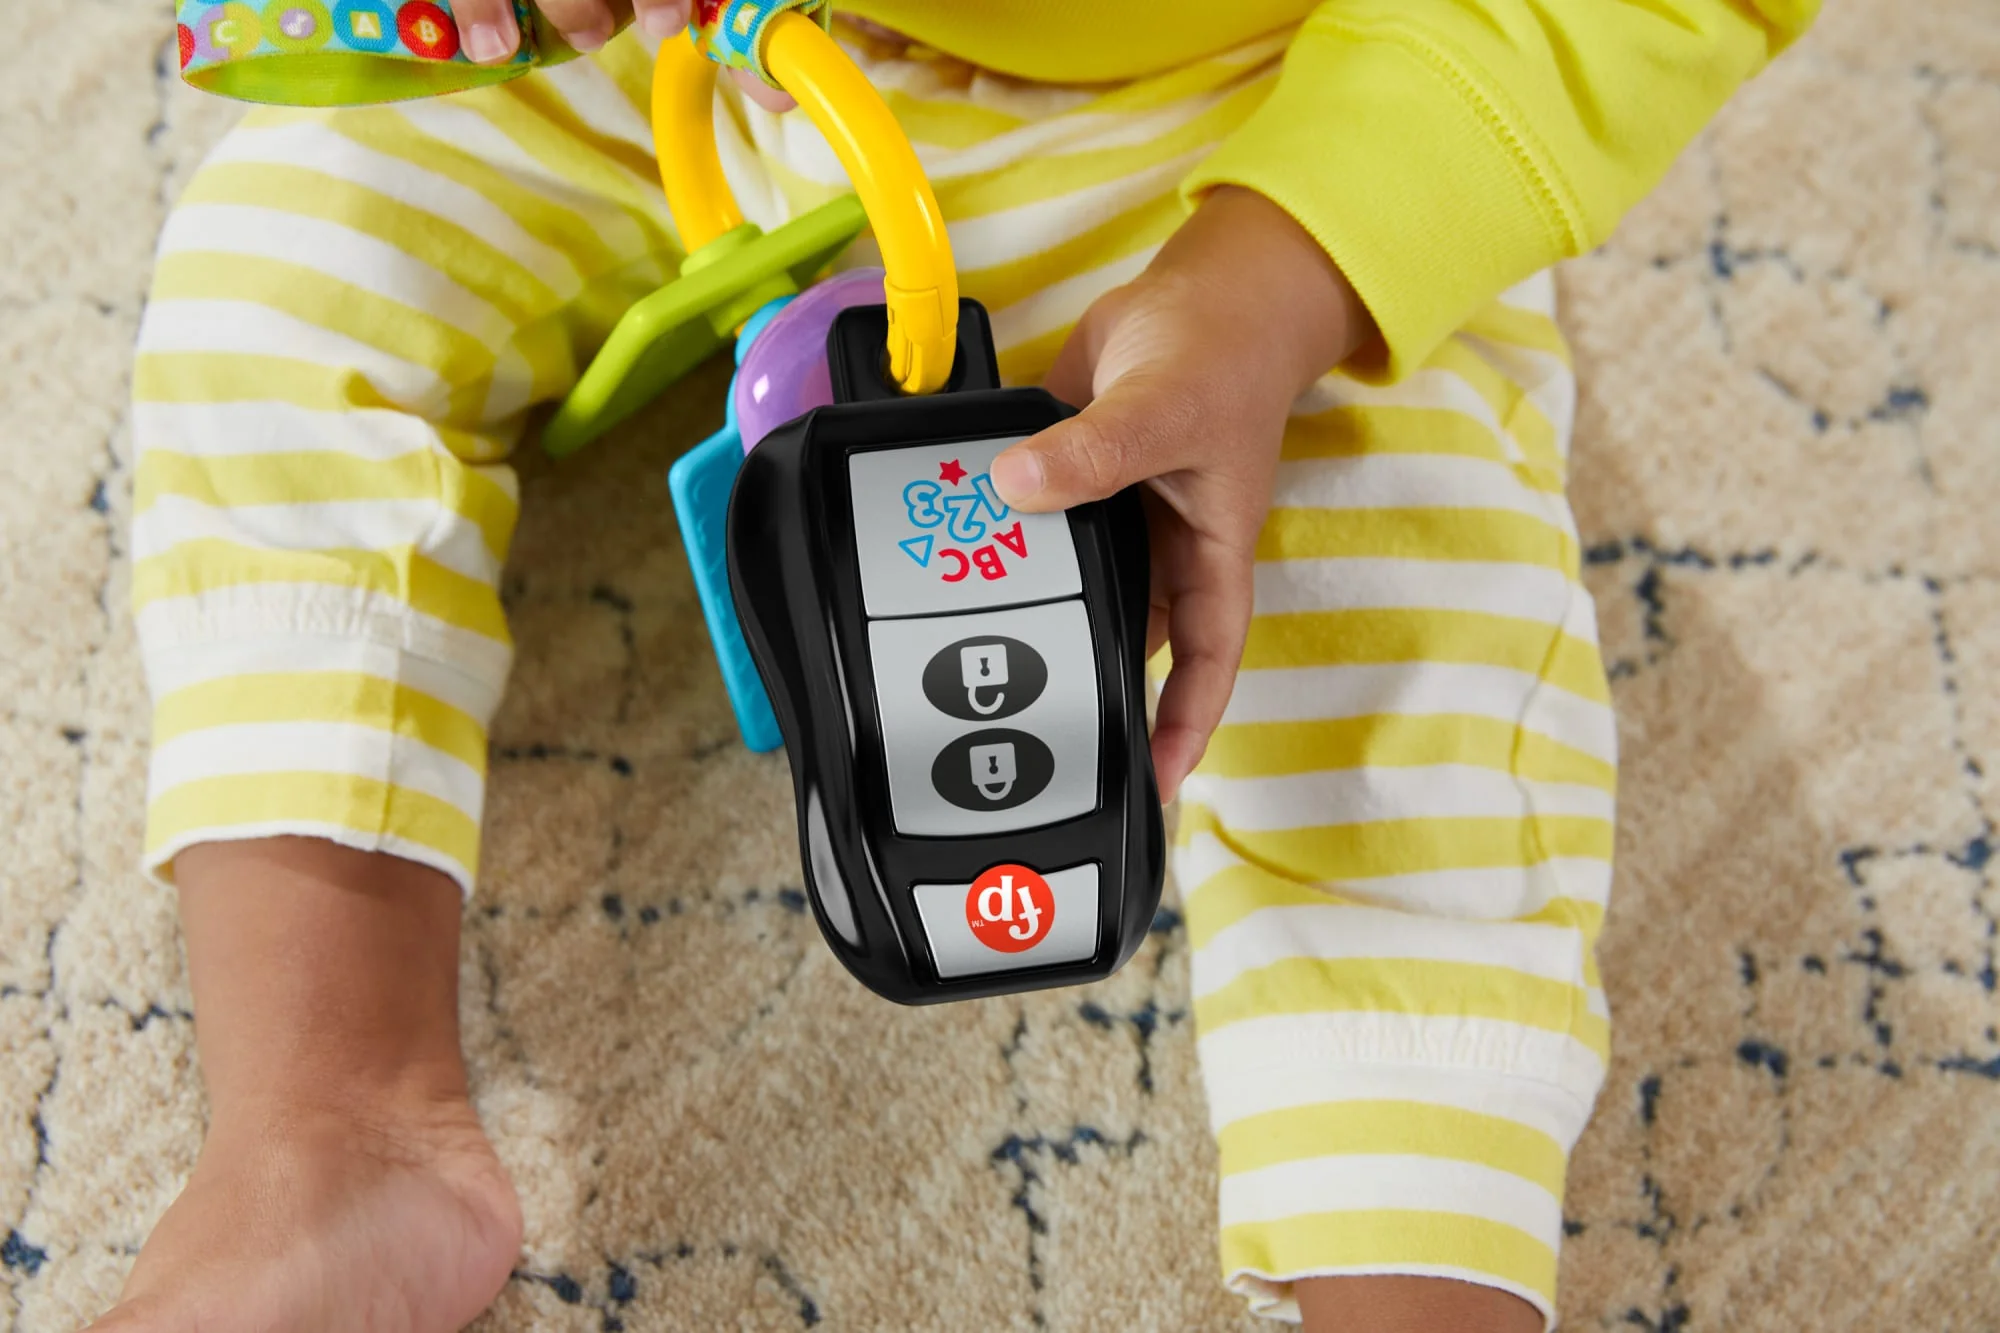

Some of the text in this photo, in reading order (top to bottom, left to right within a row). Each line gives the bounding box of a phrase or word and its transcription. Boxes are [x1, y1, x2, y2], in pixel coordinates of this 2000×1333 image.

[216, 20, 237, 42] C
[355, 13, 438, 43] A B
[938, 521, 1028, 582] ABC
[978, 875, 1043, 940] fp
